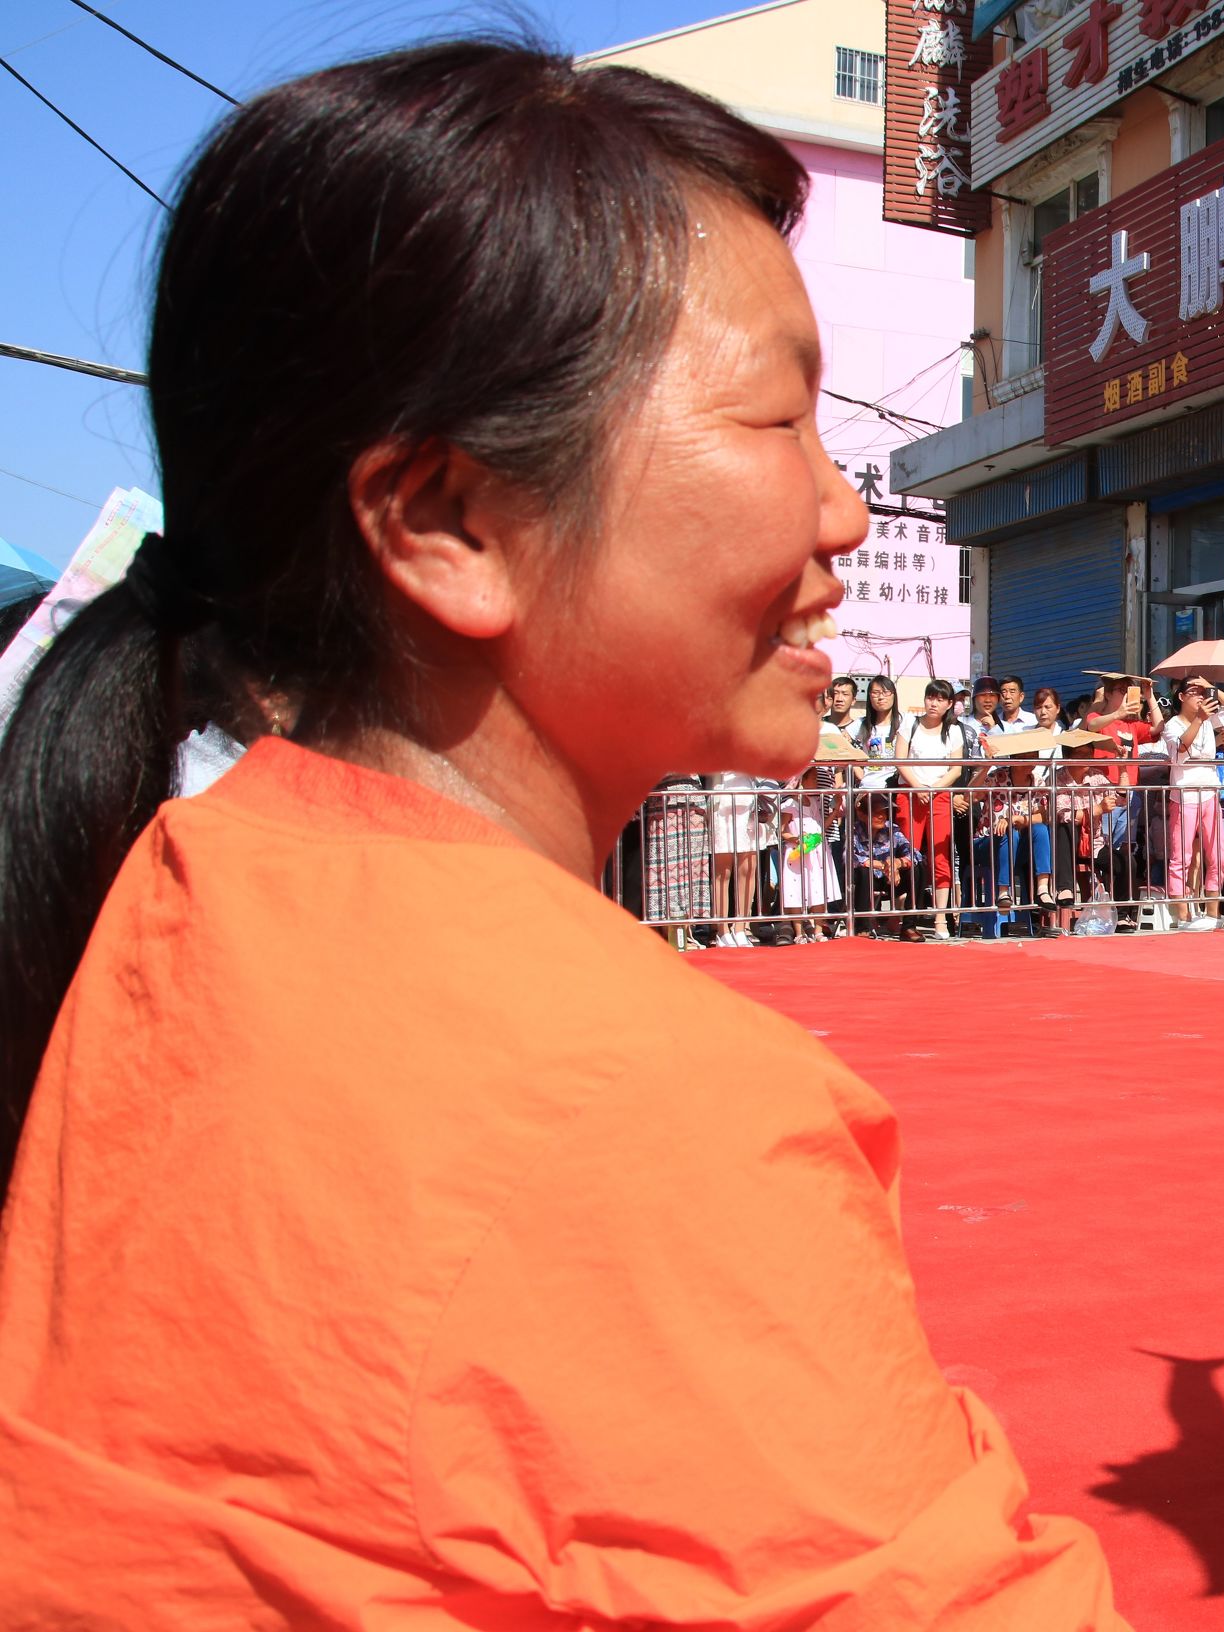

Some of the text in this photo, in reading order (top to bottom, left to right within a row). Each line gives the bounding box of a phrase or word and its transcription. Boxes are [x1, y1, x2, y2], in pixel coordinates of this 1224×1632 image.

[909, 0, 971, 198] 麟洗浴
[1103, 351, 1190, 413] 烟酒副食
[876, 521, 947, 544] 美术 音乐
[832, 549, 936, 573] 品舞编排等)
[879, 582, 949, 605] 幼小衔接
